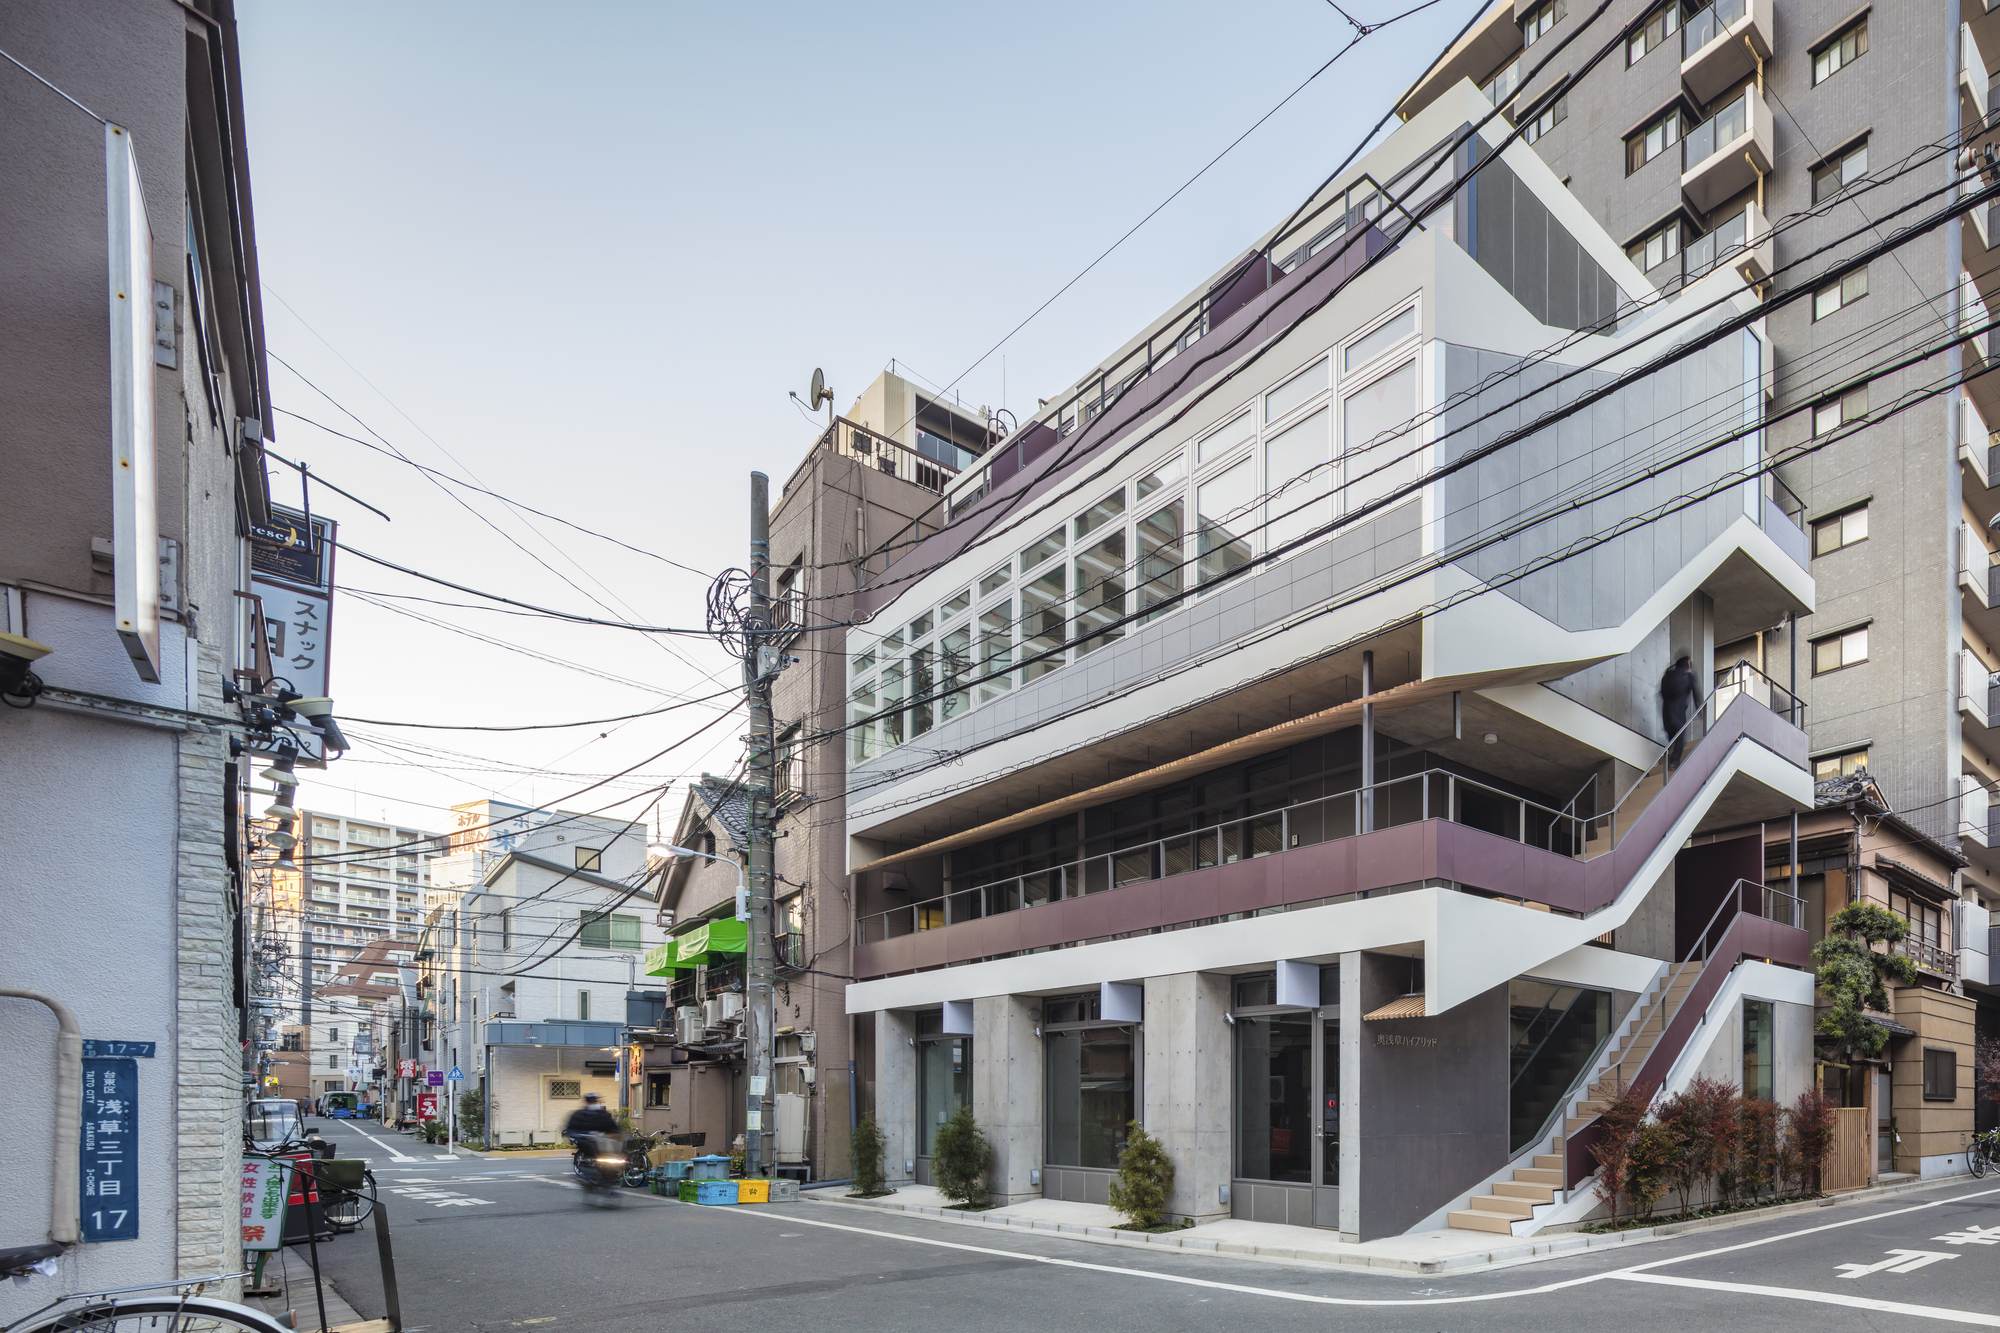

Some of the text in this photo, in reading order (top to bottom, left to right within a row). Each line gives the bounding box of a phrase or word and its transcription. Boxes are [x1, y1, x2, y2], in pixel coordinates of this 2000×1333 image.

[291, 600, 318, 671] スナック
[107, 1043, 150, 1054] 17-7
[85, 1070, 95, 1088] TAITO
[85, 1089, 95, 1104] CITY
[85, 1121, 95, 1151] ASAKUSA
[96, 1070, 123, 1196] 台東区 浅草三丁目
[91, 1209, 129, 1230] 17
